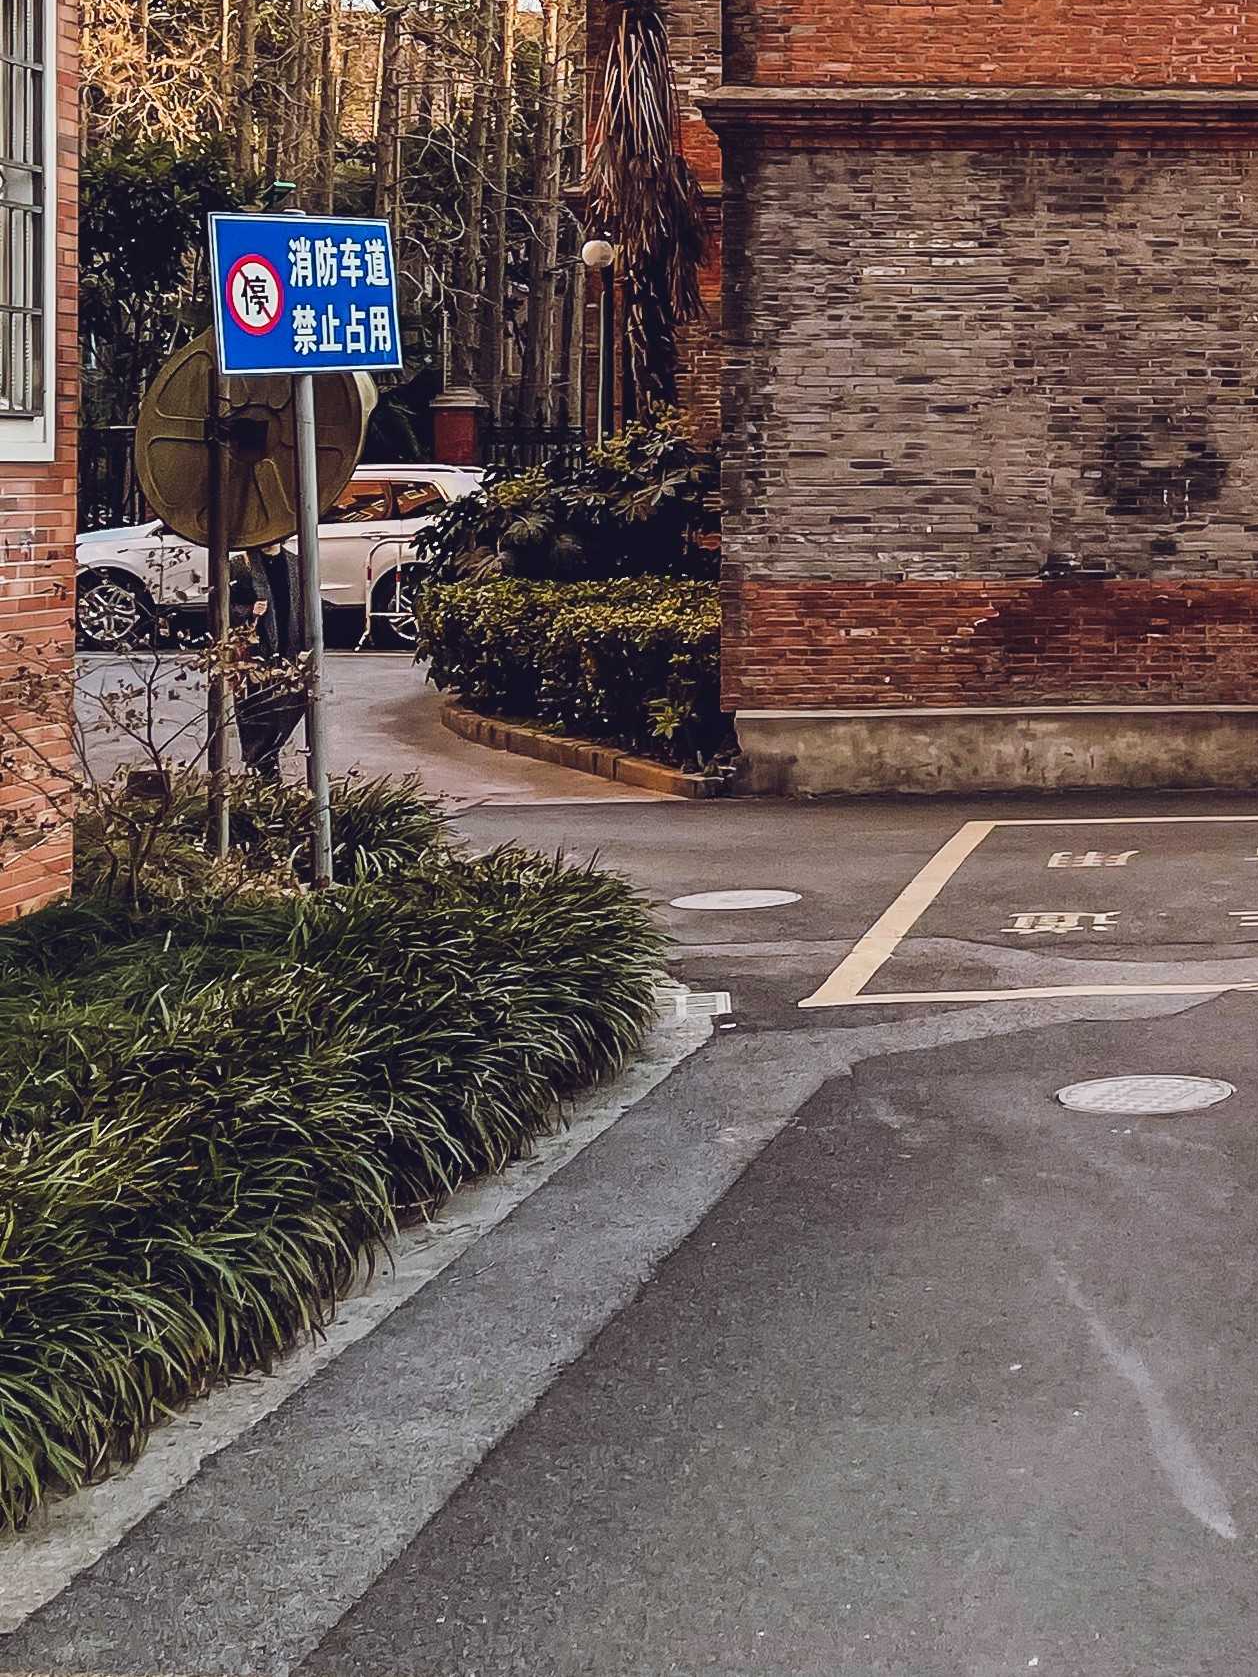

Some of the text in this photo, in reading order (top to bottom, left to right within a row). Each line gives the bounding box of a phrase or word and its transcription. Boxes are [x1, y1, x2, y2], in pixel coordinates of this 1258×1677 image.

[288, 236, 390, 288] 消防车道
[241, 275, 270, 316] 停
[292, 304, 392, 355] 禁止占用
